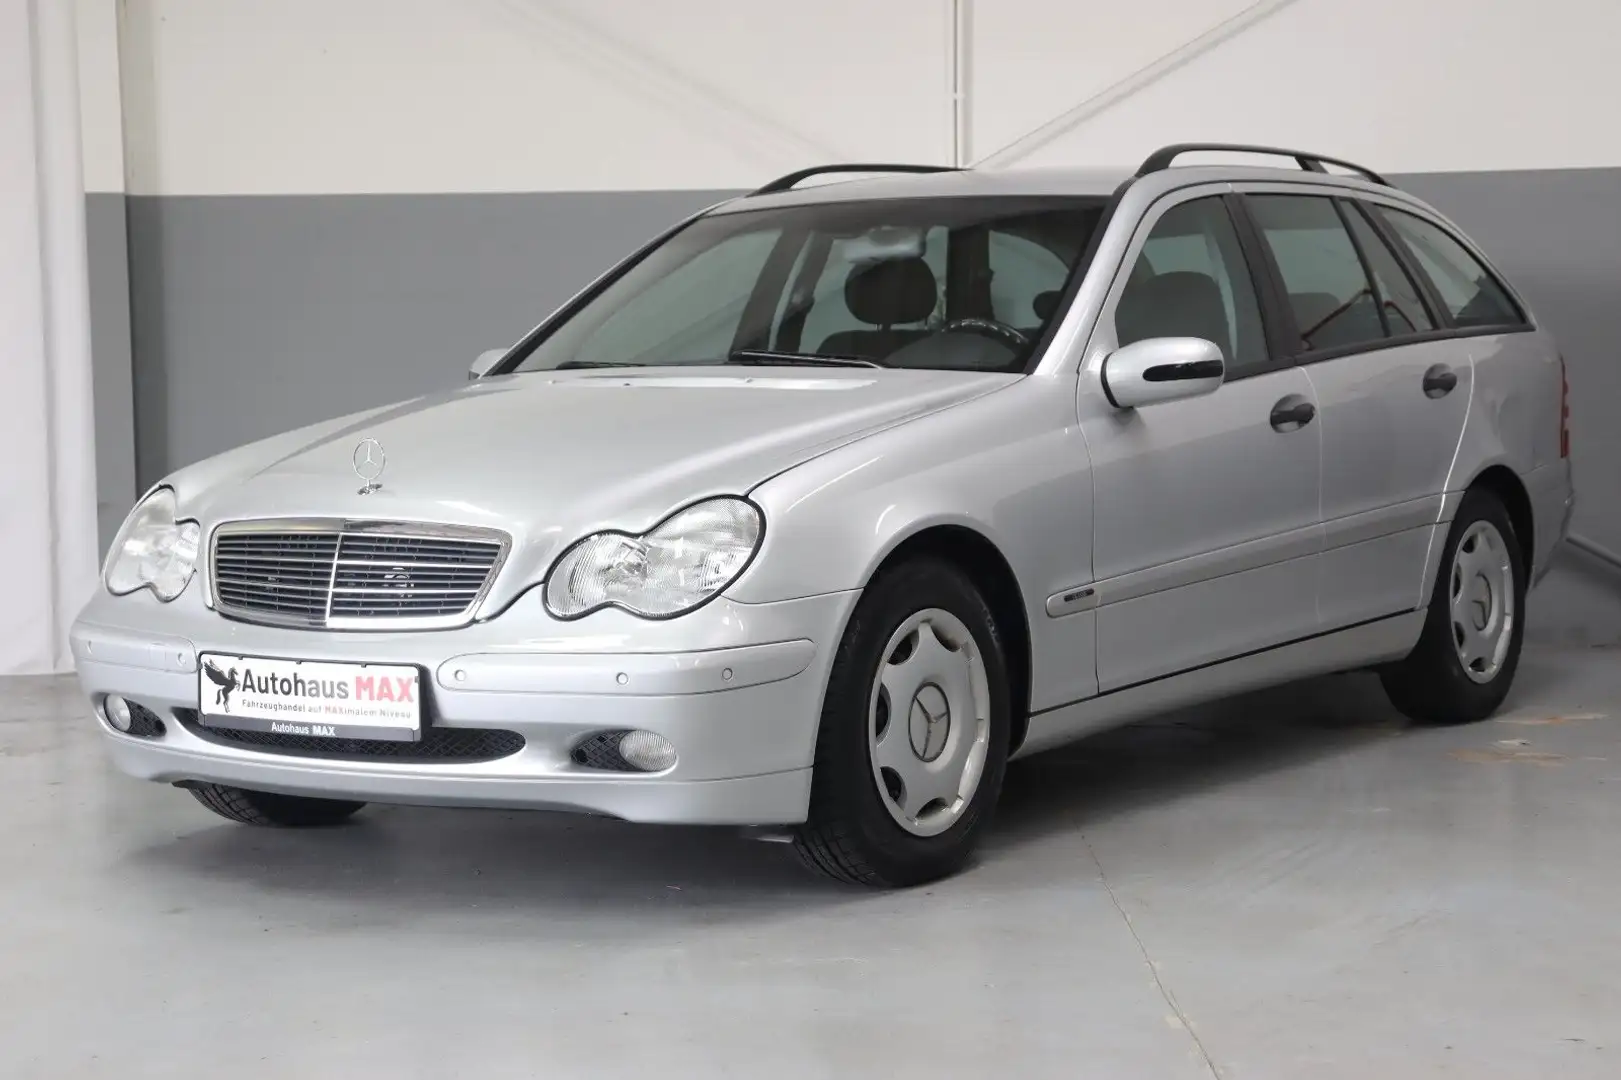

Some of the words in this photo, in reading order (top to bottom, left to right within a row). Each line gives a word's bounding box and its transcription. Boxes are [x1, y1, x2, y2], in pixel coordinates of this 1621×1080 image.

[242, 669, 349, 699] Autohaus
[355, 675, 414, 702] MAX
[242, 699, 306, 712] Fahrzeughandel
[307, 705, 322, 713] auf
[324, 706, 377, 716] MAXimalem
[379, 709, 412, 719] Niveau
[271, 721, 310, 734] Autohaus
[312, 726, 336, 736] MAX
